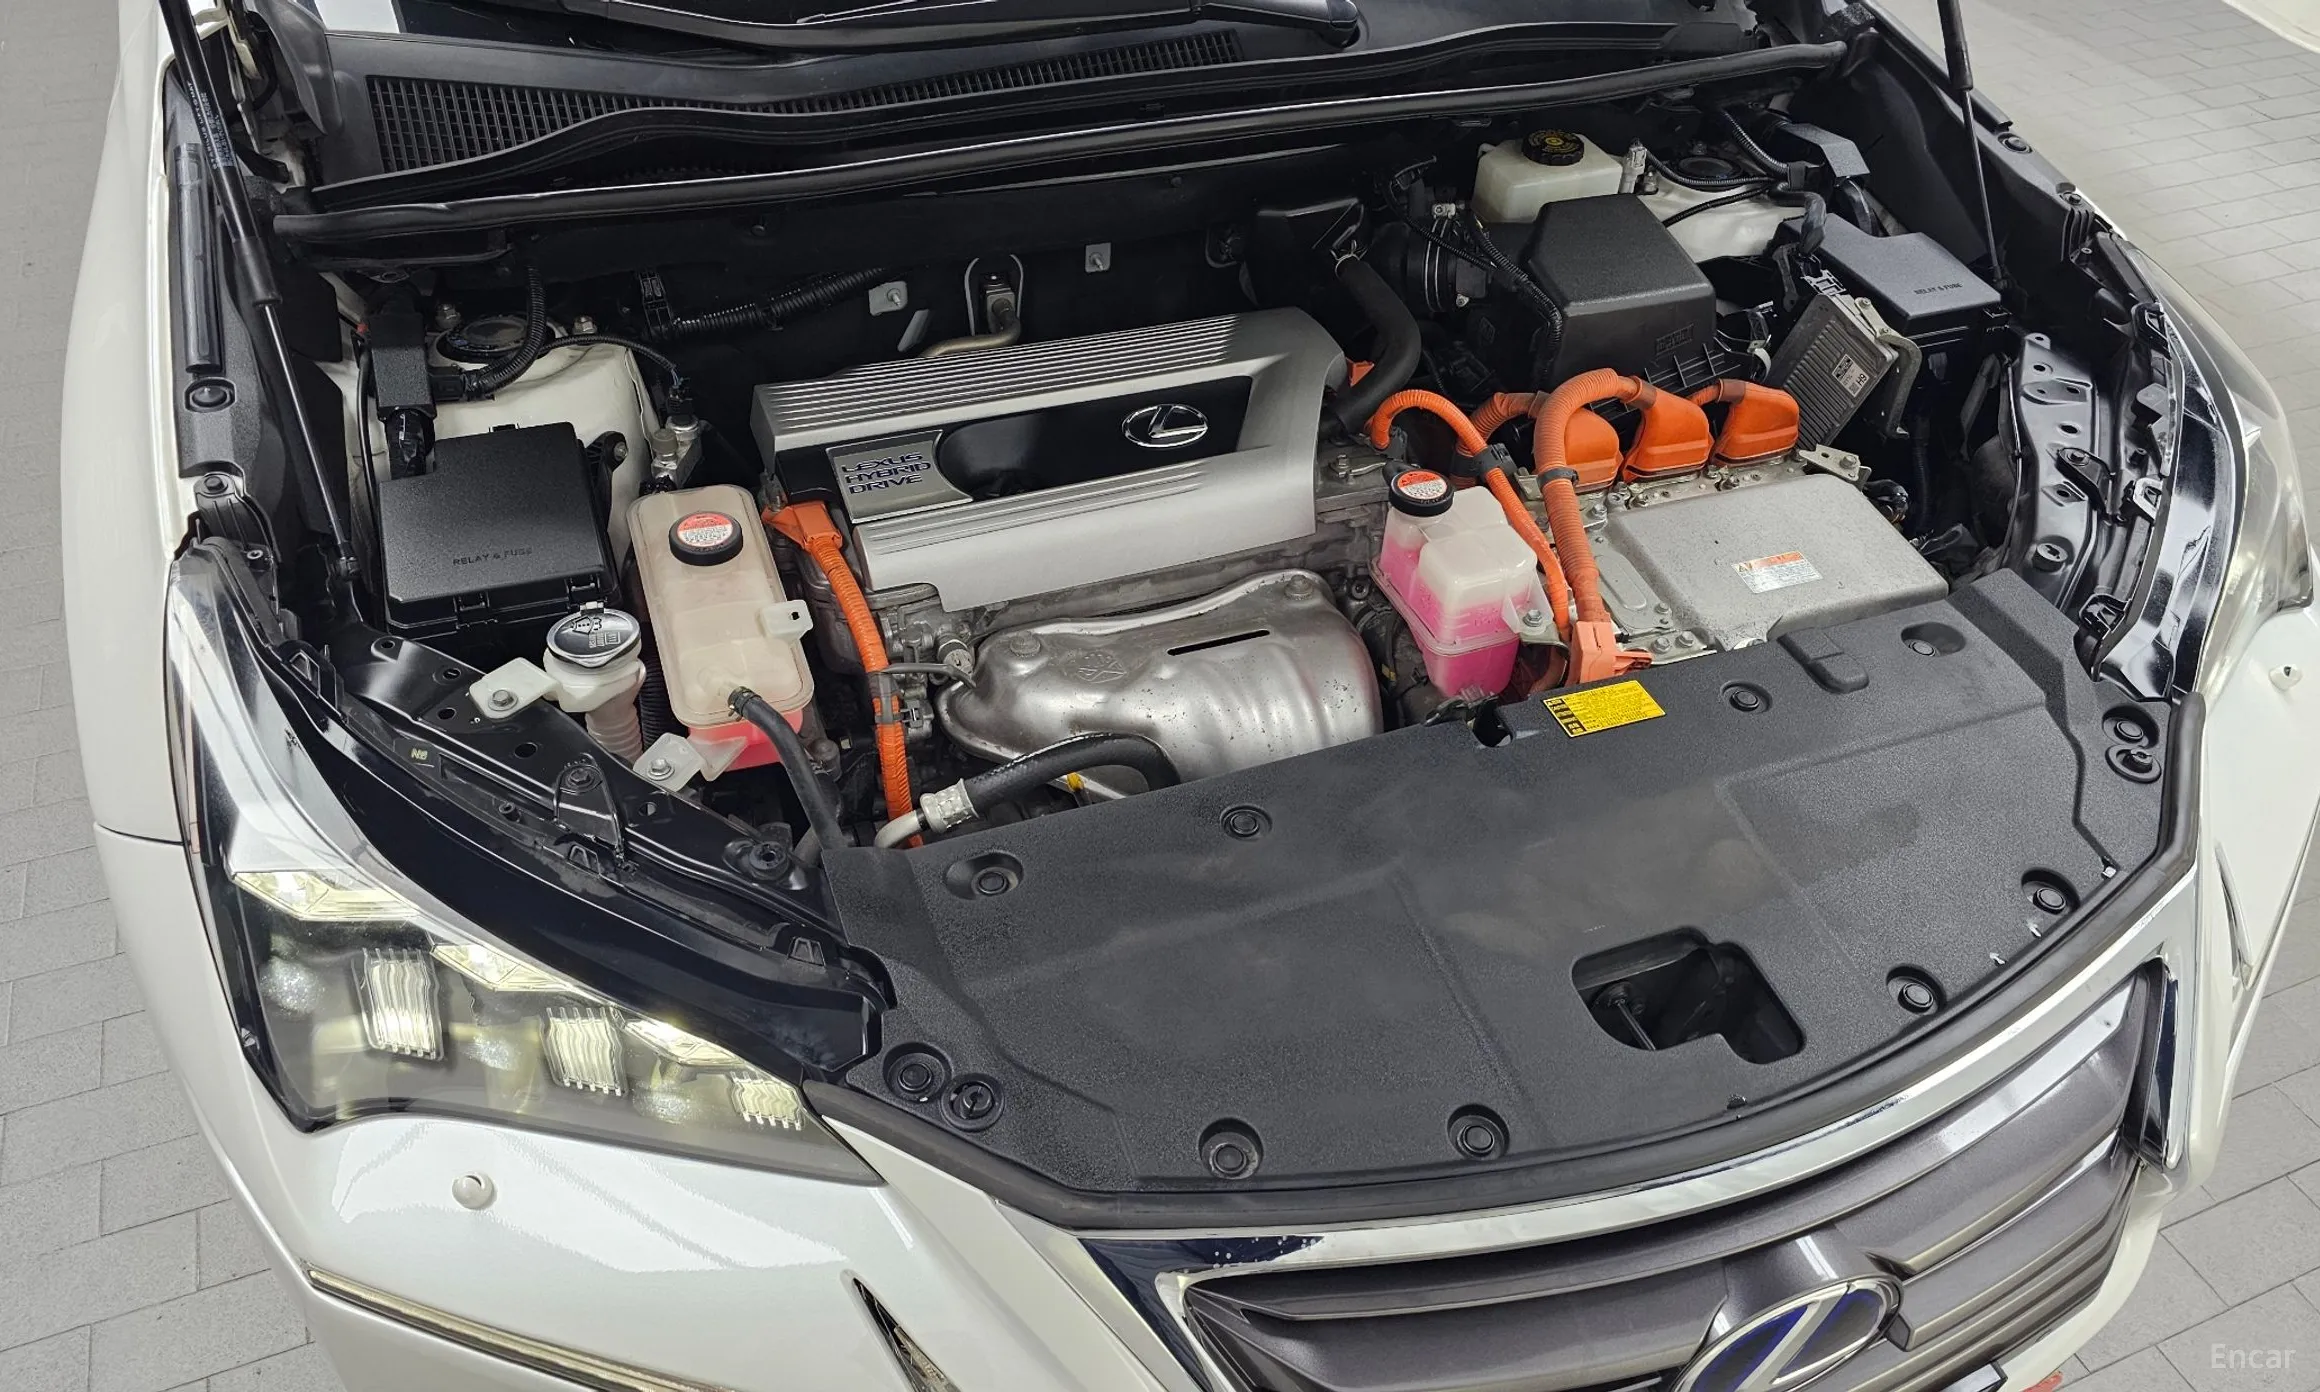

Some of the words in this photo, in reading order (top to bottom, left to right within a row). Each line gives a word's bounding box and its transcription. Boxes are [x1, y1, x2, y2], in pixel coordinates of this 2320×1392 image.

[842, 452, 923, 473] LEXUS
[845, 462, 932, 484] HYBRID
[849, 474, 923, 494] DRIVE
[452, 553, 489, 566] RELAY
[503, 547, 532, 558] FUSE
